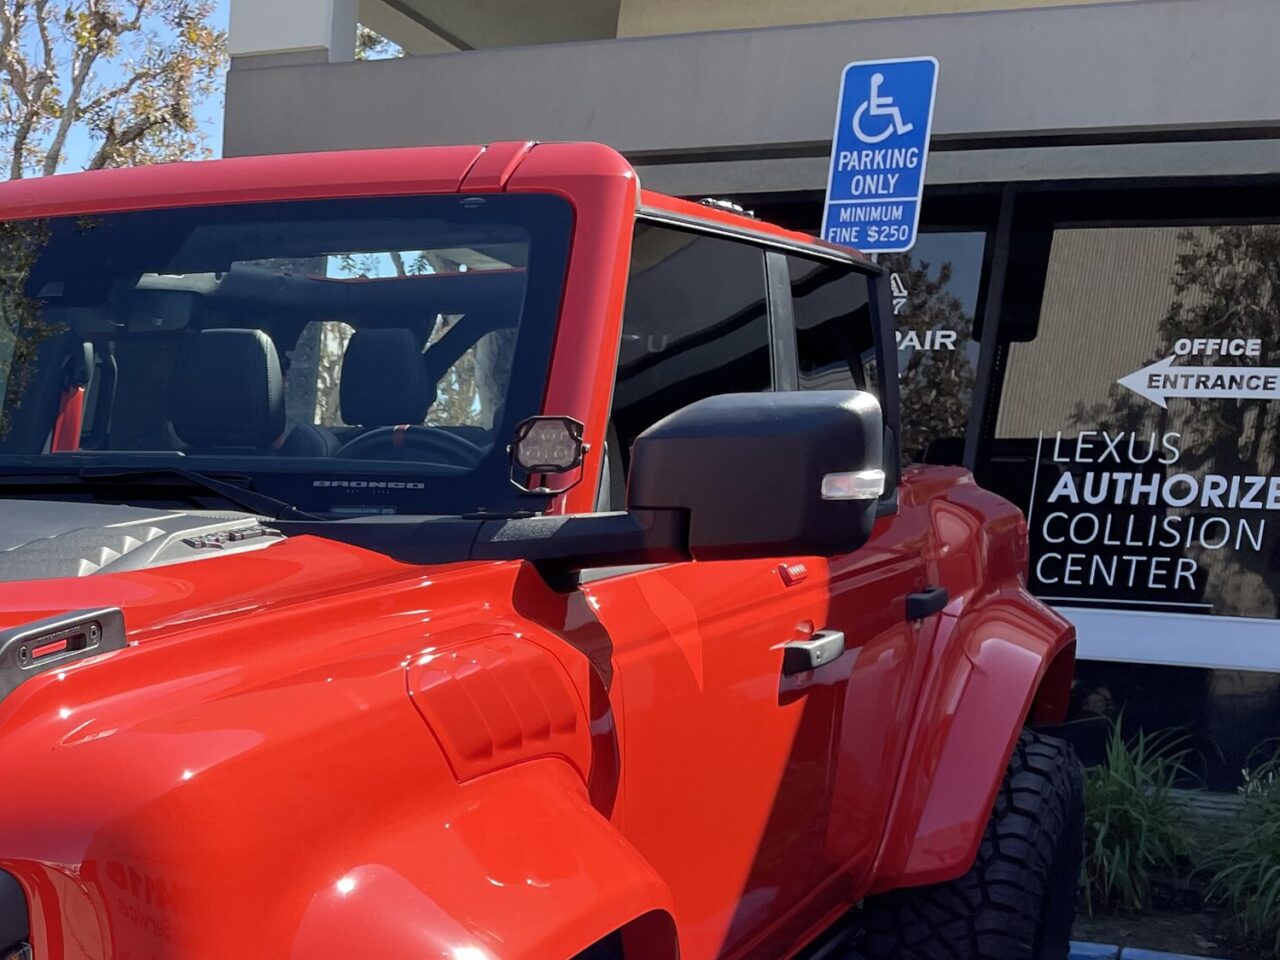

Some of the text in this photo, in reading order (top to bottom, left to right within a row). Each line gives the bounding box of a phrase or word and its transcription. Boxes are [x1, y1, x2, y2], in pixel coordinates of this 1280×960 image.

[837, 146, 919, 172] PARKING
[850, 172, 900, 196] ONLY
[838, 204, 904, 223] MINIMUM
[827, 224, 909, 244] FINE $250
[1173, 337, 1262, 357] OFFICE
[1146, 373, 1279, 392] ENTRANCE
[1052, 430, 1182, 465] LEXUS
[312, 480, 426, 490] BRONCO
[1041, 511, 1266, 552] COLLISION
[1035, 552, 1198, 591] CENTER
